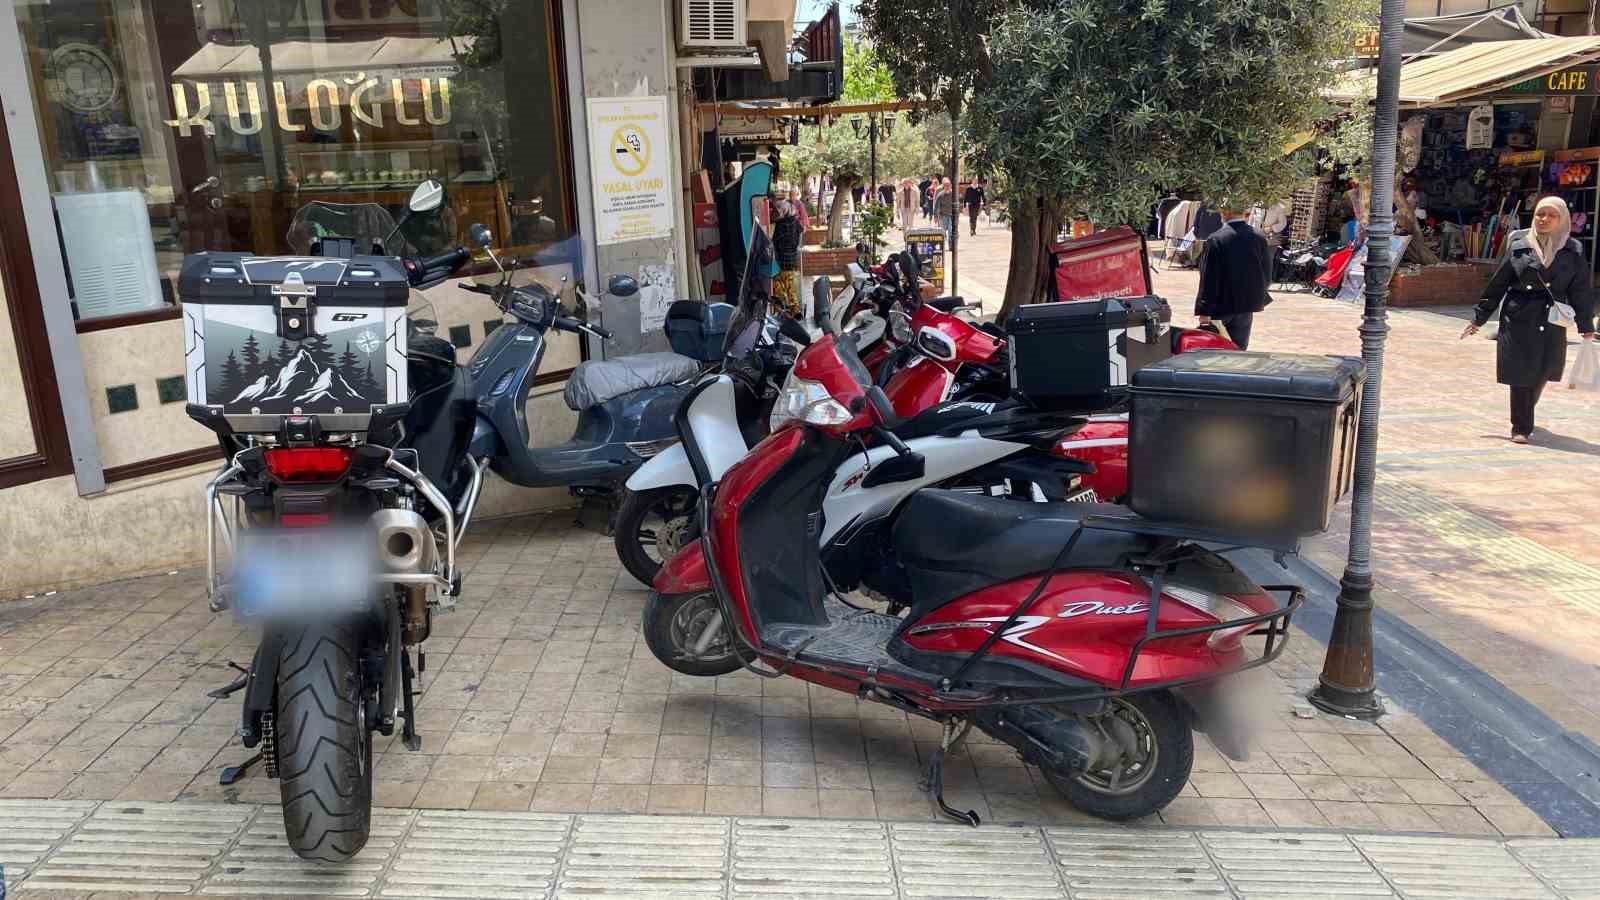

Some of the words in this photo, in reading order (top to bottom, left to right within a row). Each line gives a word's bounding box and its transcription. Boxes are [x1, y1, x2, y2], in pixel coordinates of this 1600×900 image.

[1548, 71, 1587, 90] CAFE
[163, 72, 451, 137] KULOĞLU
[602, 181, 632, 193] YASAL
[633, 177, 663, 190] UYARI
[1057, 600, 1151, 617] Duet
